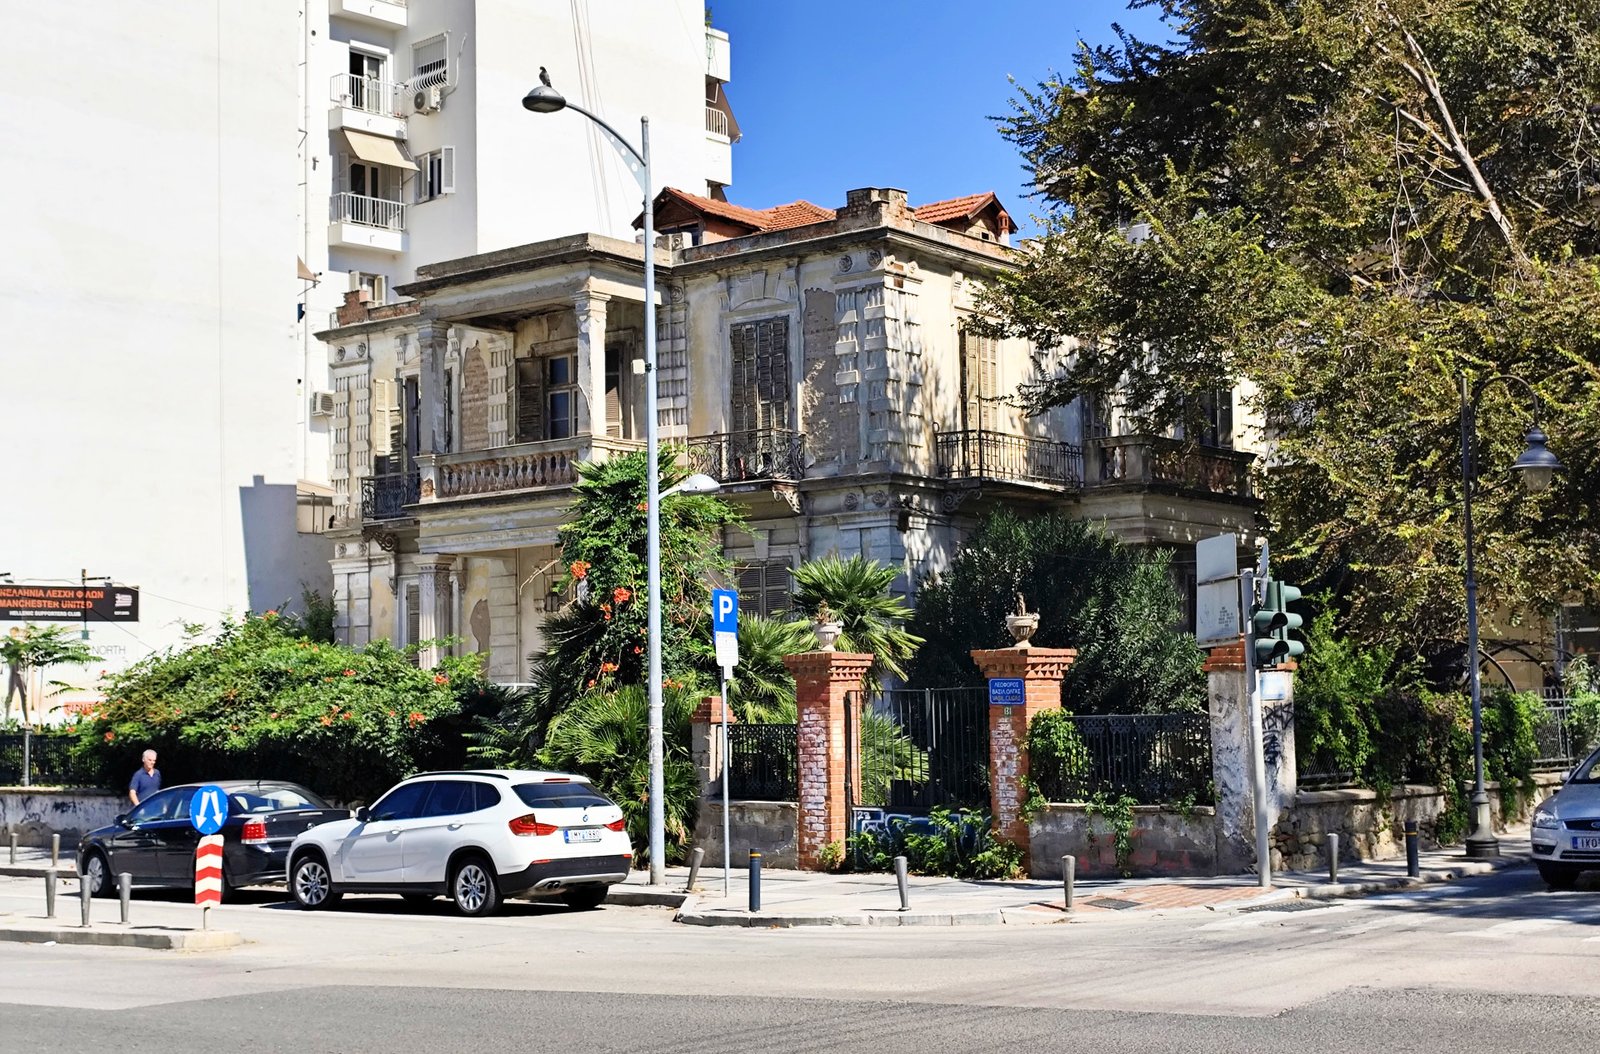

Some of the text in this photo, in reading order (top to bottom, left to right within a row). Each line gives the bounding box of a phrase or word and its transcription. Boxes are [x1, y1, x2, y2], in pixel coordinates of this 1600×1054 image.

[46, 590, 74, 598] ΛΕΣΧΗ
[76, 591, 104, 599] ΦΛΩΝ
[0, 599, 60, 608] MANCHESTER
[719, 595, 733, 623] P
[92, 645, 126, 655] NORTH
